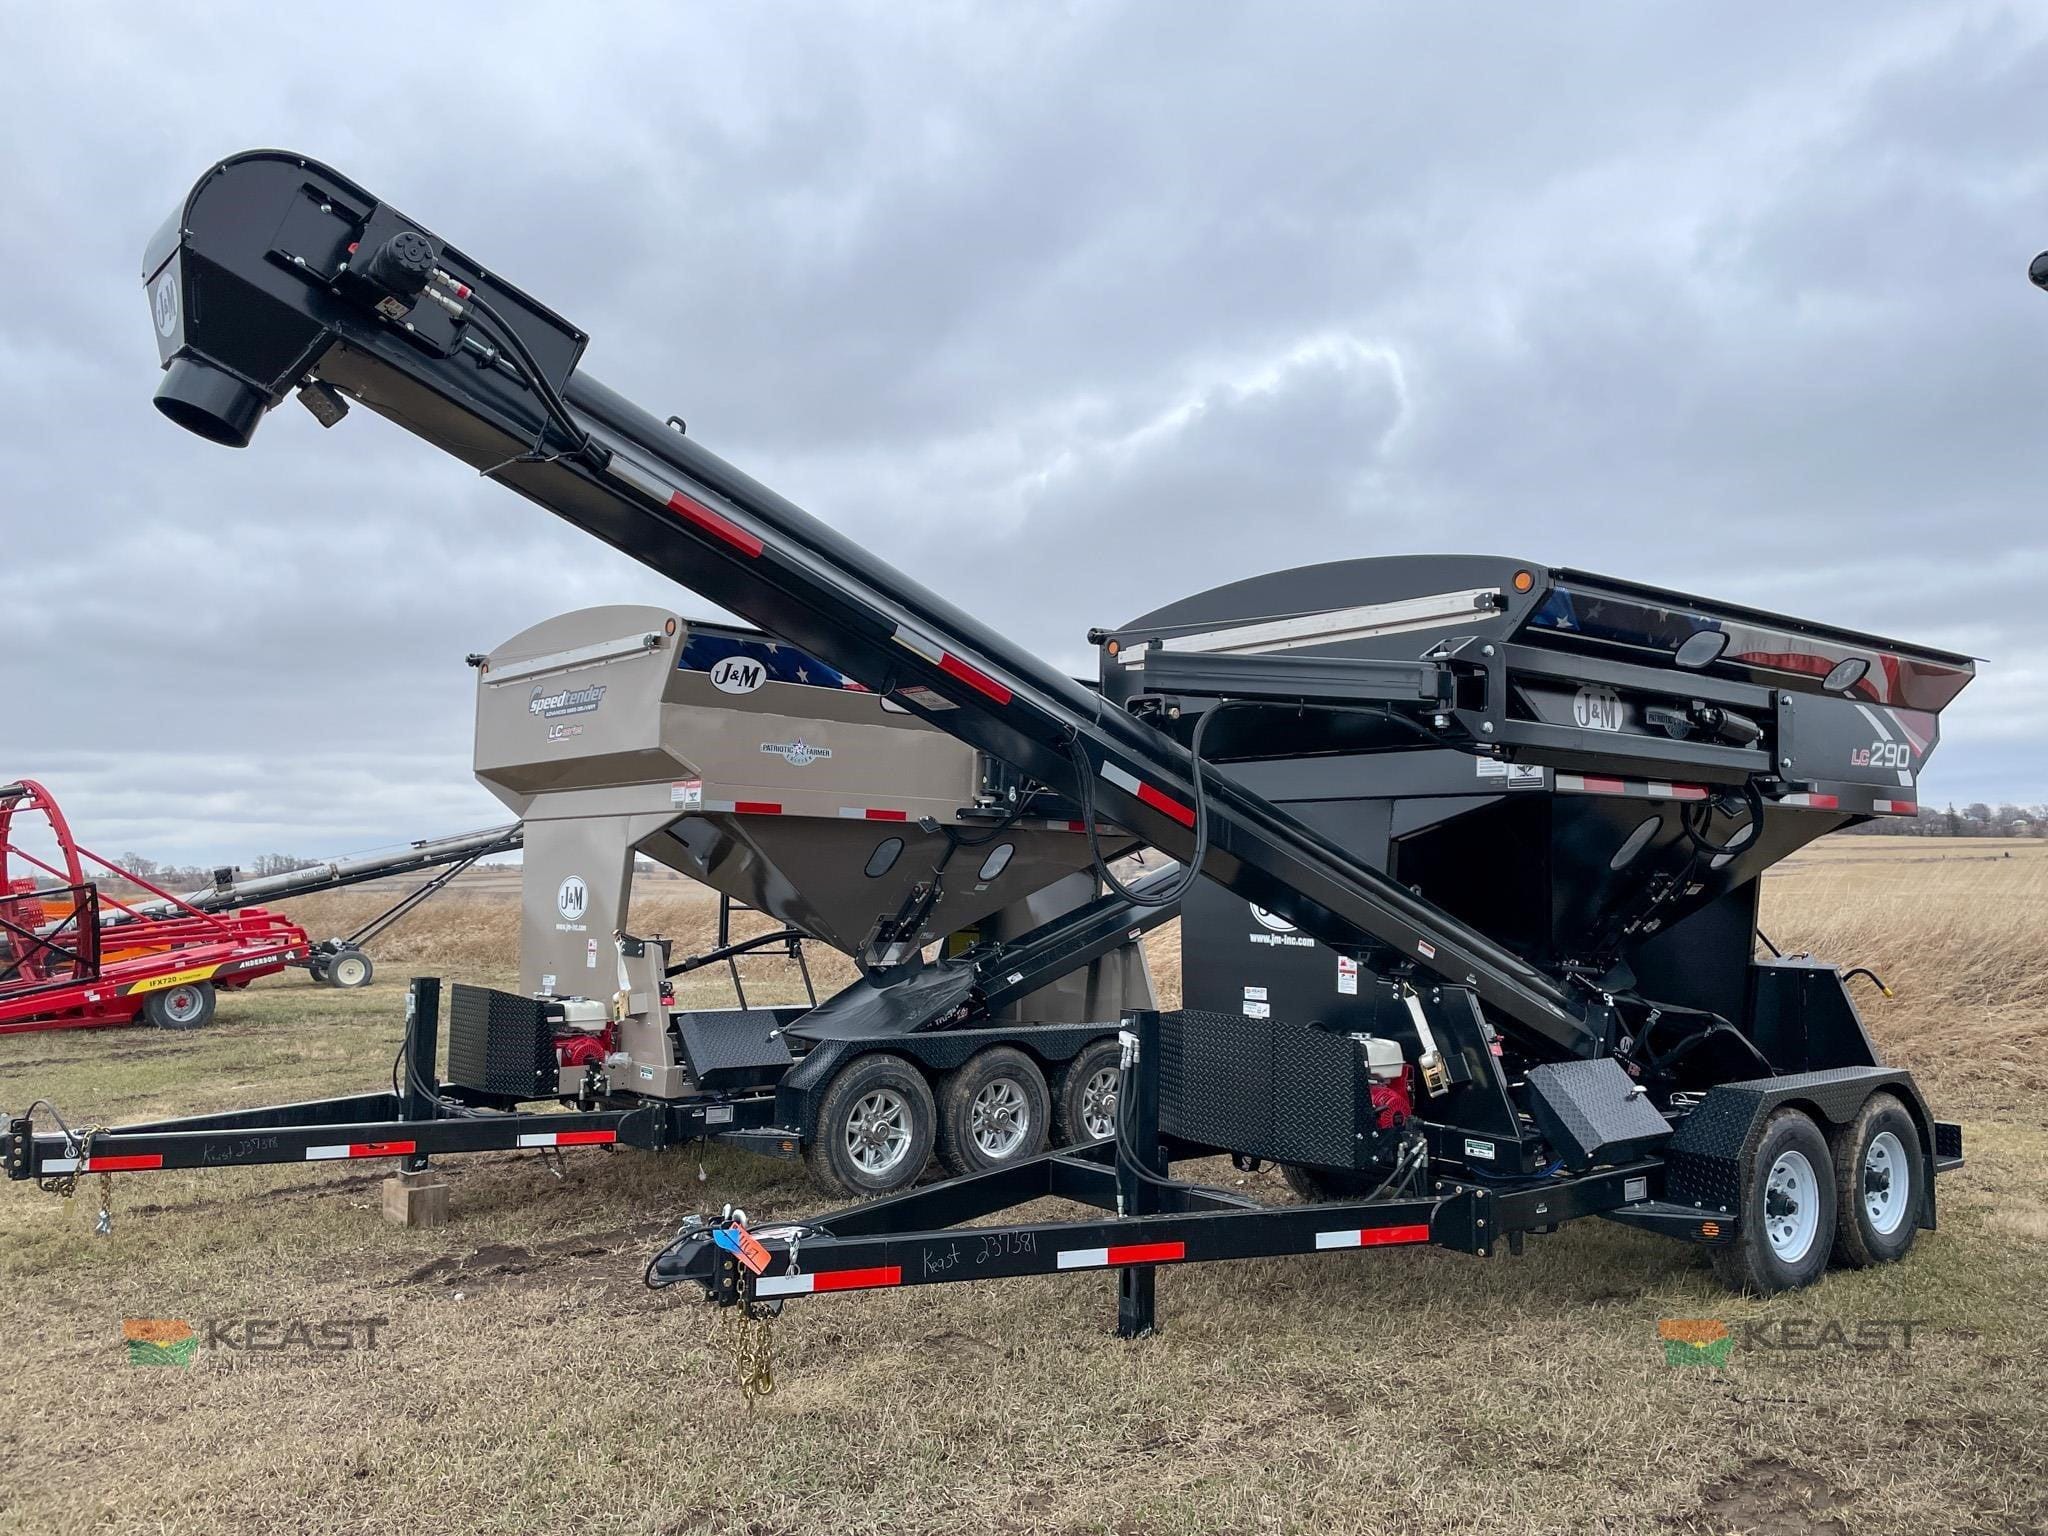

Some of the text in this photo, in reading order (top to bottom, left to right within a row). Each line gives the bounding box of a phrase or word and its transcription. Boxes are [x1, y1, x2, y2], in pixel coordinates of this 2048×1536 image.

[158, 280, 177, 328] J&M
[714, 663, 760, 688] J&M
[1577, 693, 1616, 729] J&M
[762, 744, 830, 757] PATRIOTIC FARMER
[561, 886, 583, 911] J&M
[1249, 933, 1315, 947] www.jm-inc.com
[239, 955, 278, 969] ANDERSON
[149, 976, 177, 987] IFX720
[923, 1229, 1037, 1278] Keast 237381
